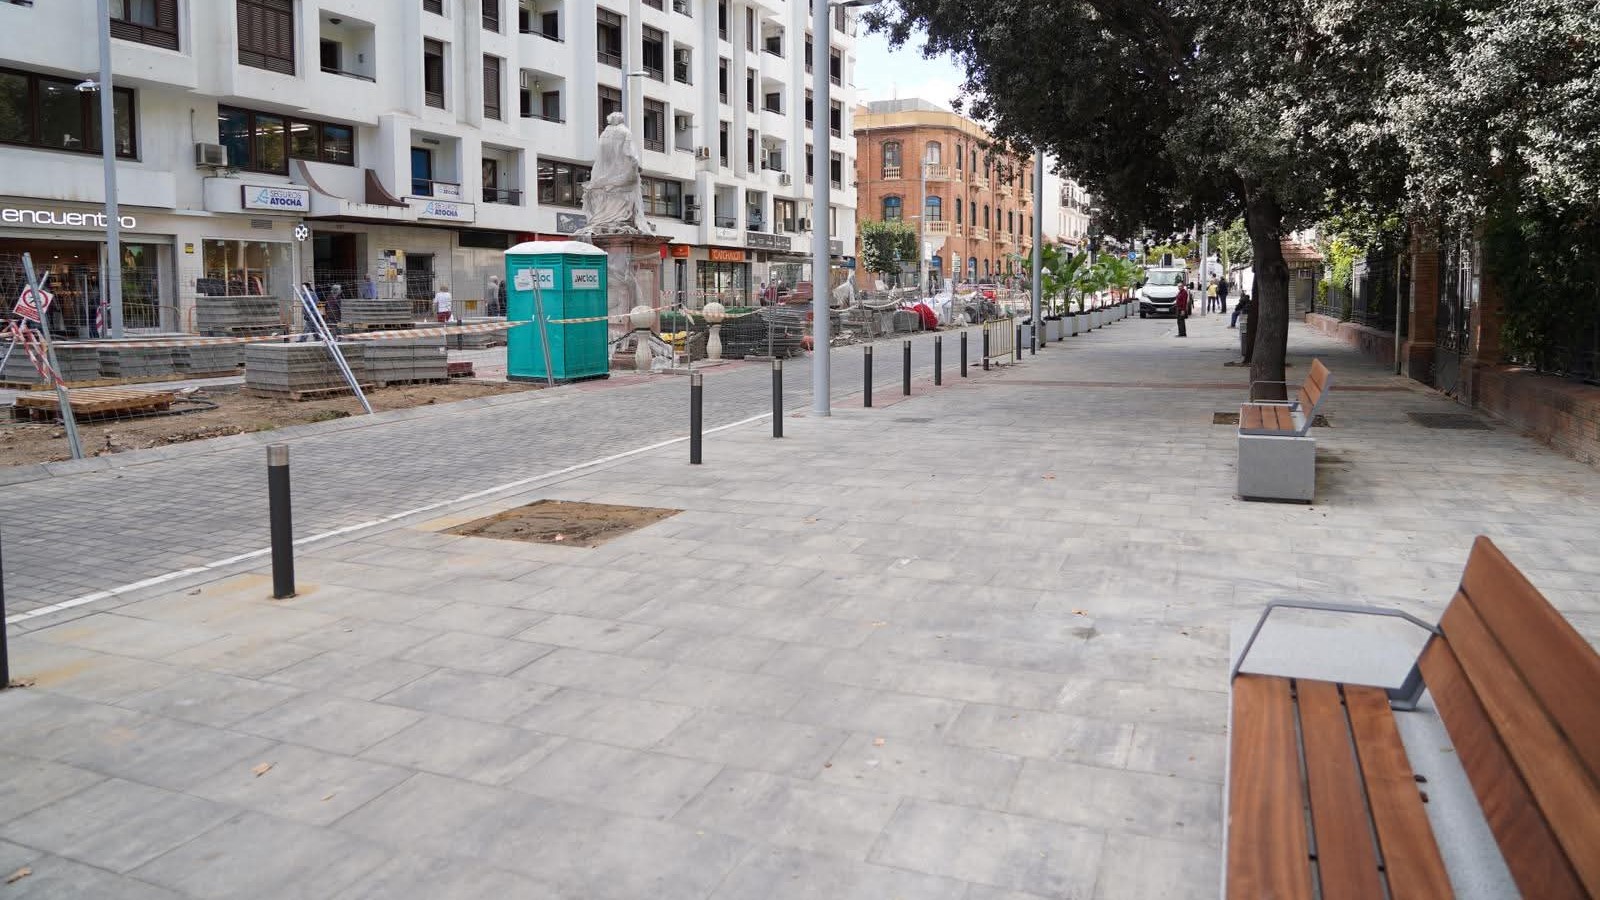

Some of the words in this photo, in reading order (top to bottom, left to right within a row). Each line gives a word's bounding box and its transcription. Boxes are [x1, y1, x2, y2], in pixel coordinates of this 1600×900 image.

[269, 189, 302, 199] SEGUROS
[269, 197, 303, 207] ATOCHA
[434, 201, 458, 211] SEGUROS
[434, 208, 458, 217] ATOCHA
[2, 208, 136, 229] encuento
